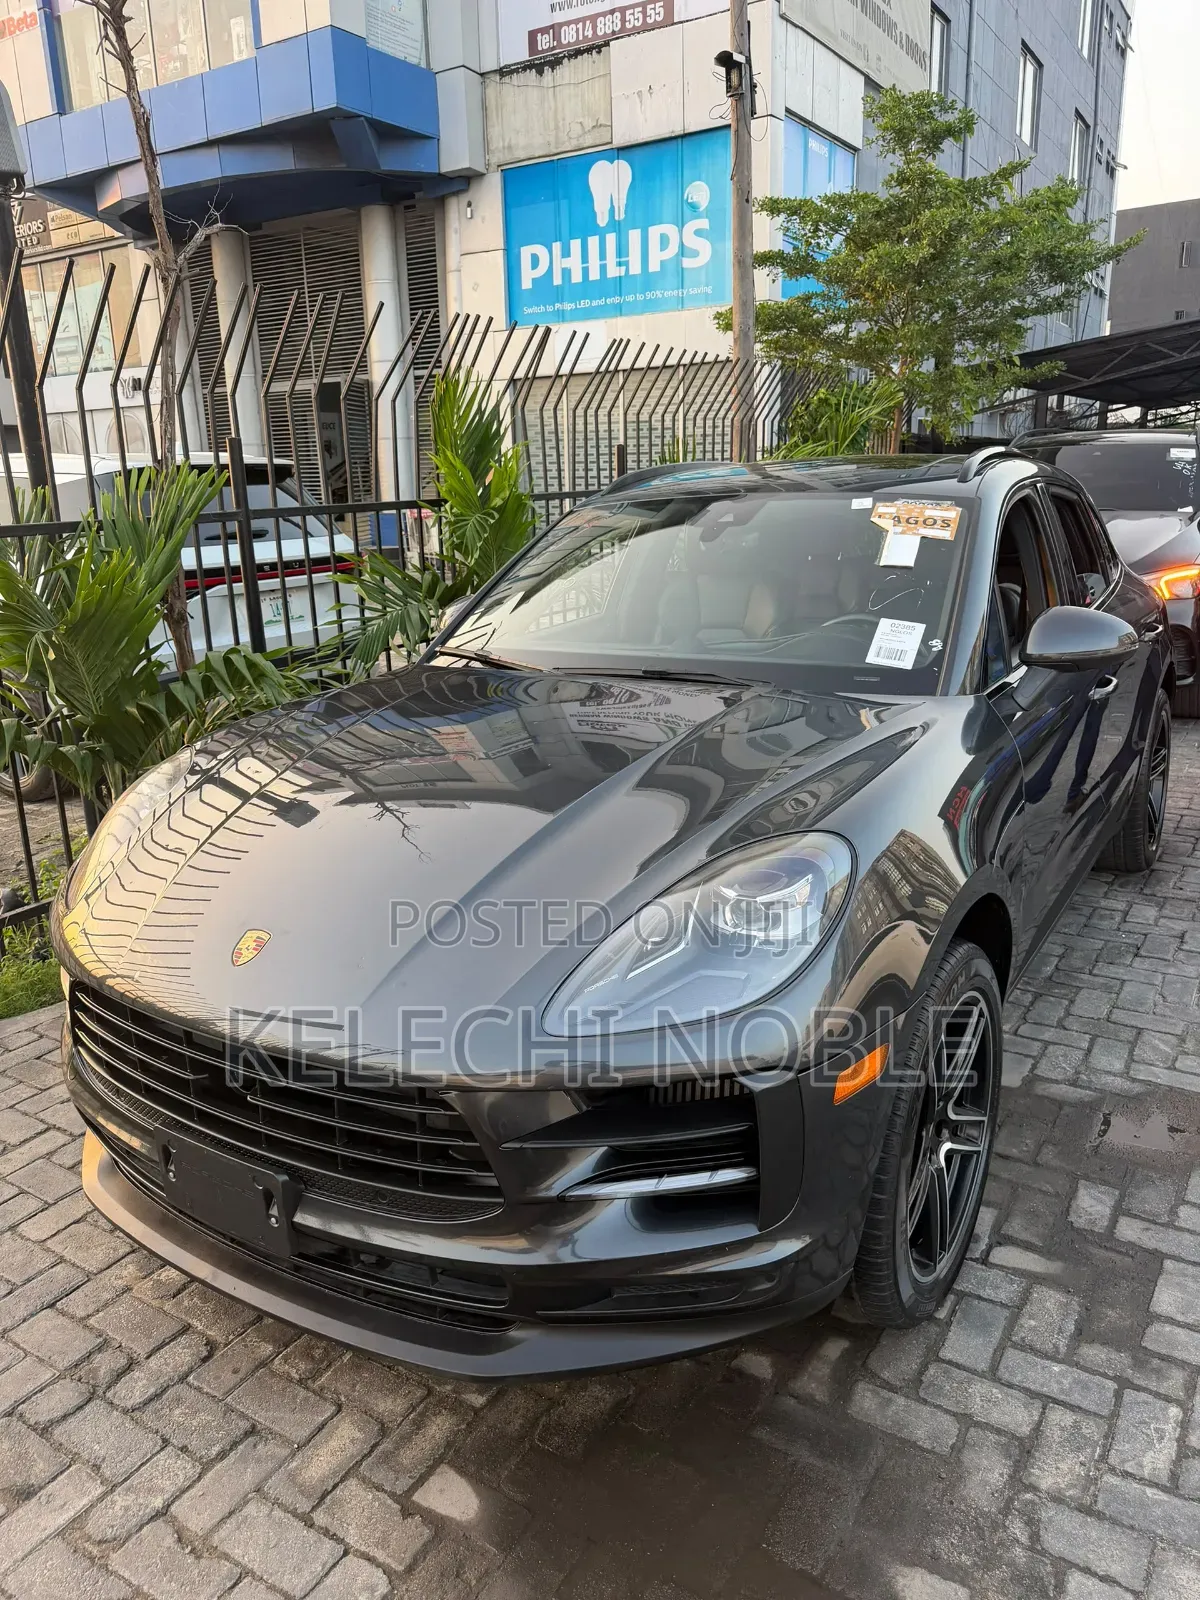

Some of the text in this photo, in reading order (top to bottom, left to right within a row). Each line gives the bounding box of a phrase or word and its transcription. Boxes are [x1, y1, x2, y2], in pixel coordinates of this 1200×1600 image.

[536, 2, 664, 51] tel. 0814 888 55 55
[808, 137, 828, 157] PHILIPS
[14, 219, 44, 238] ERIORS
[17, 236, 38, 248] ITED
[520, 218, 712, 290] PHILIPS
[523, 305, 546, 315] Switch
[546, 304, 554, 312] to
[554, 302, 576, 312] Philips
[576, 300, 591, 308] LED
[591, 298, 606, 307] and
[625, 294, 636, 304] up
[636, 293, 645, 301] to
[664, 287, 688, 299] energy
[689, 284, 713, 296] saving
[878, 513, 952, 528] AGOS
